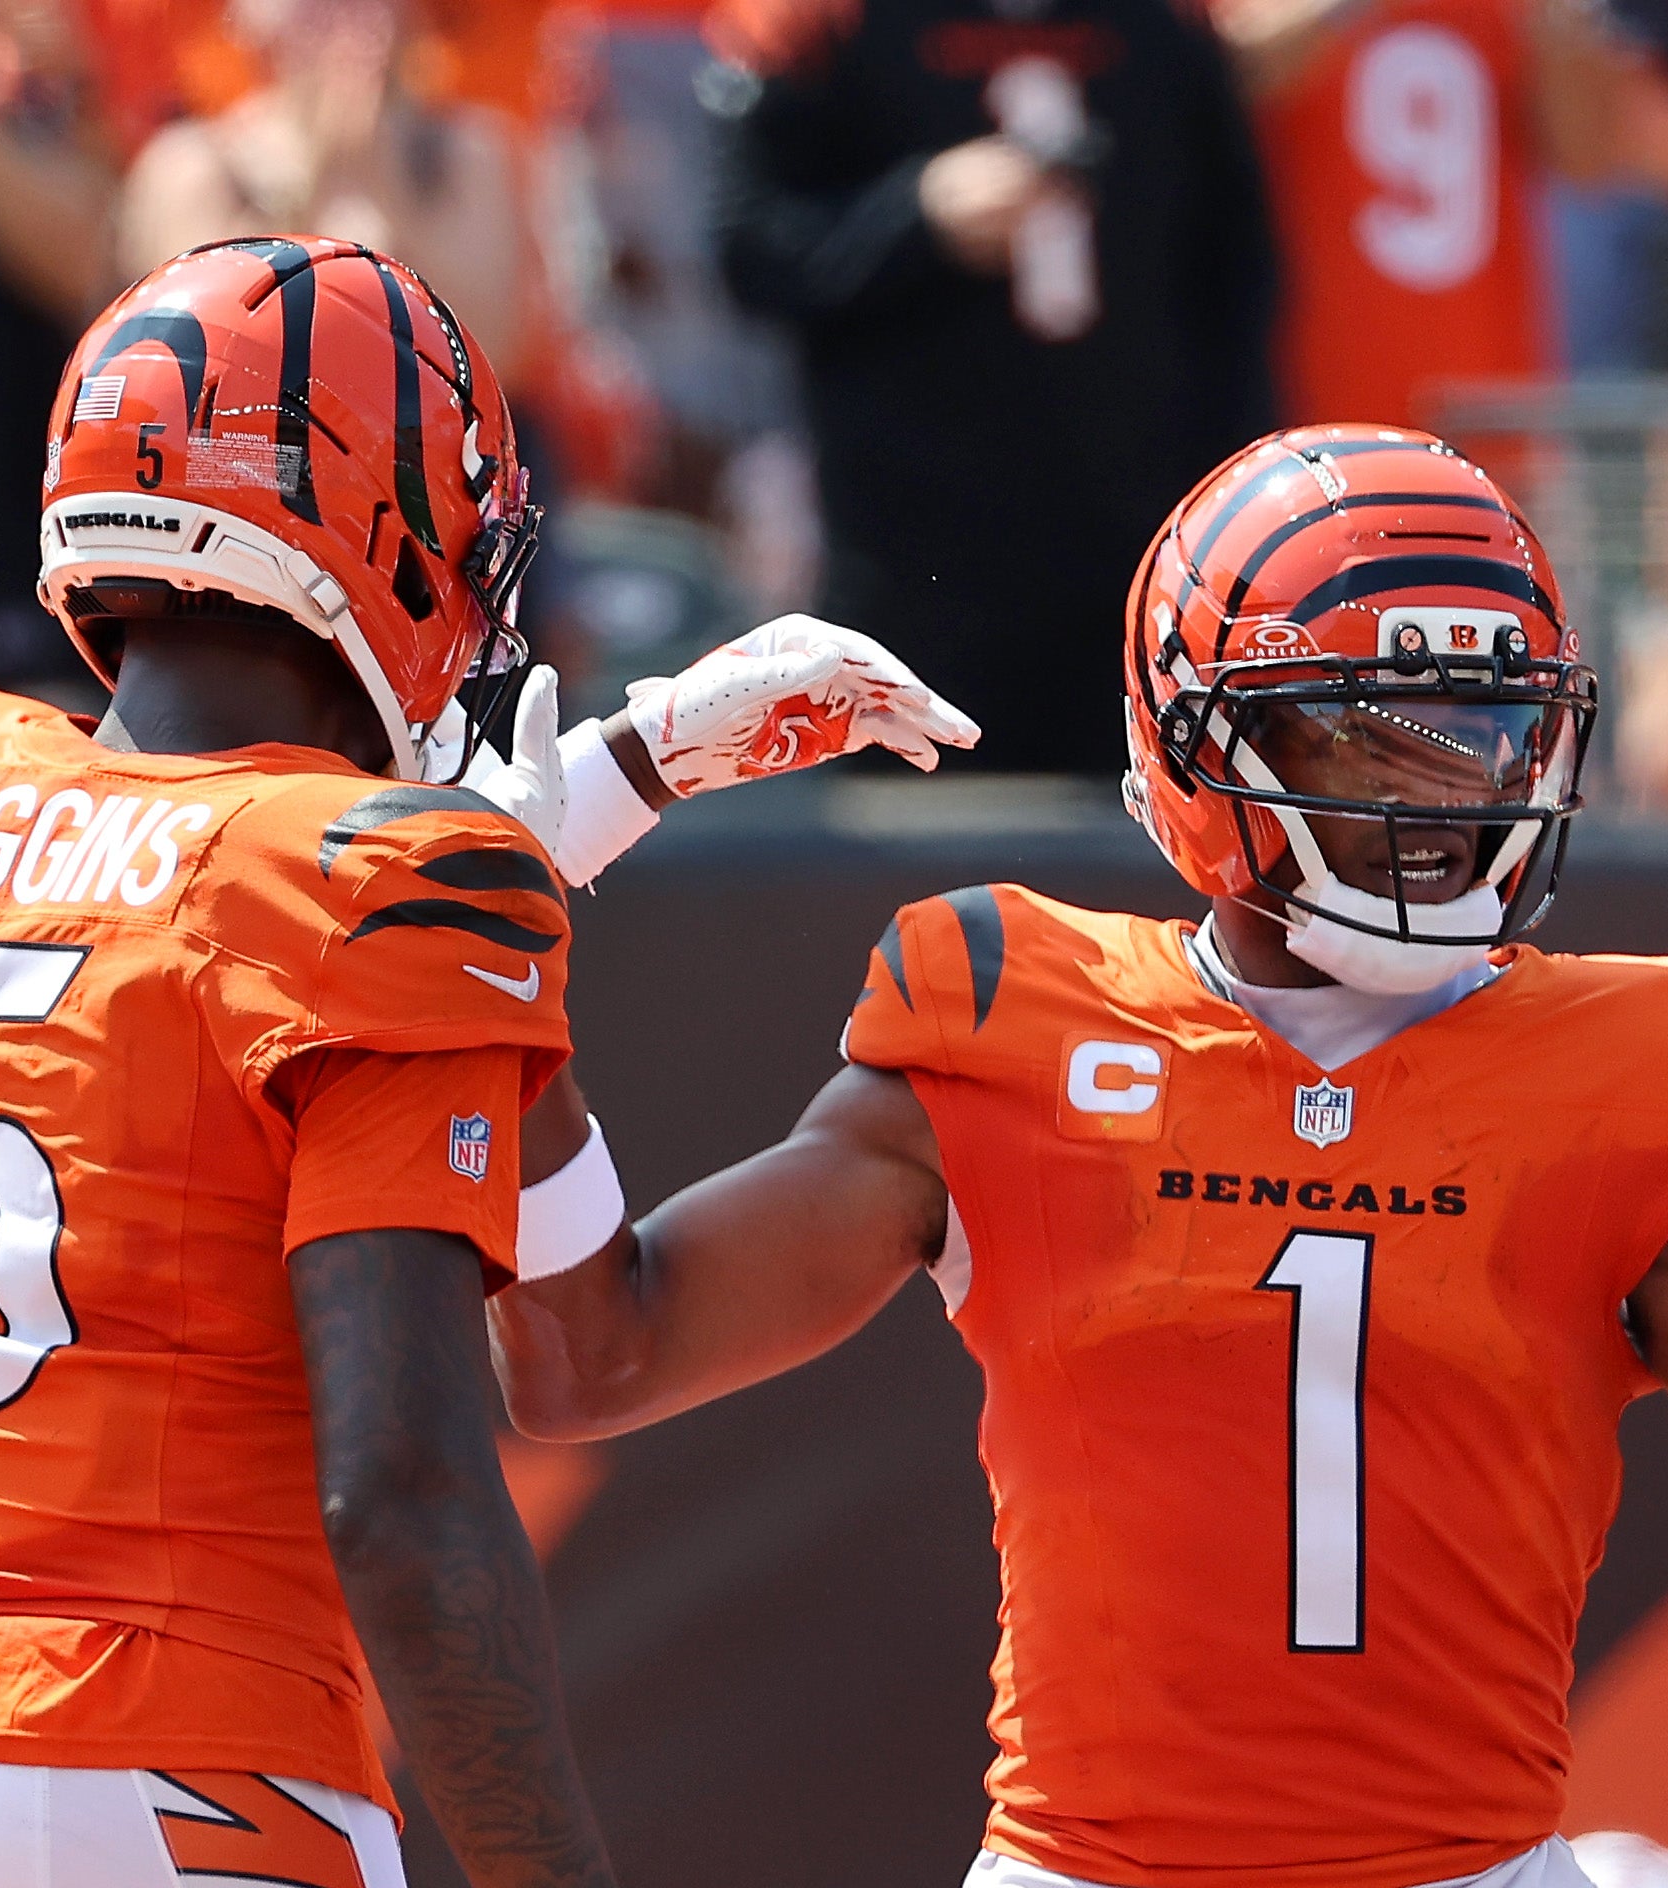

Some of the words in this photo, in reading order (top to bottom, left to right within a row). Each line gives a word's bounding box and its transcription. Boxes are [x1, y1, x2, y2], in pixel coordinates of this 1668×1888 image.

[1343, 22, 1498, 291] 9
[136, 423, 167, 489] 5
[222, 431, 268, 443] WARNING
[65, 513, 180, 532] BENGALS
[1246, 646, 1309, 658] OAKLEY
[1067, 1039, 1161, 1113] C
[1304, 1107, 1341, 1133] NFL
[457, 1141, 487, 1173] NF
[1157, 1169, 1468, 1217] BENGALS
[1254, 1228, 1374, 1654] 1
